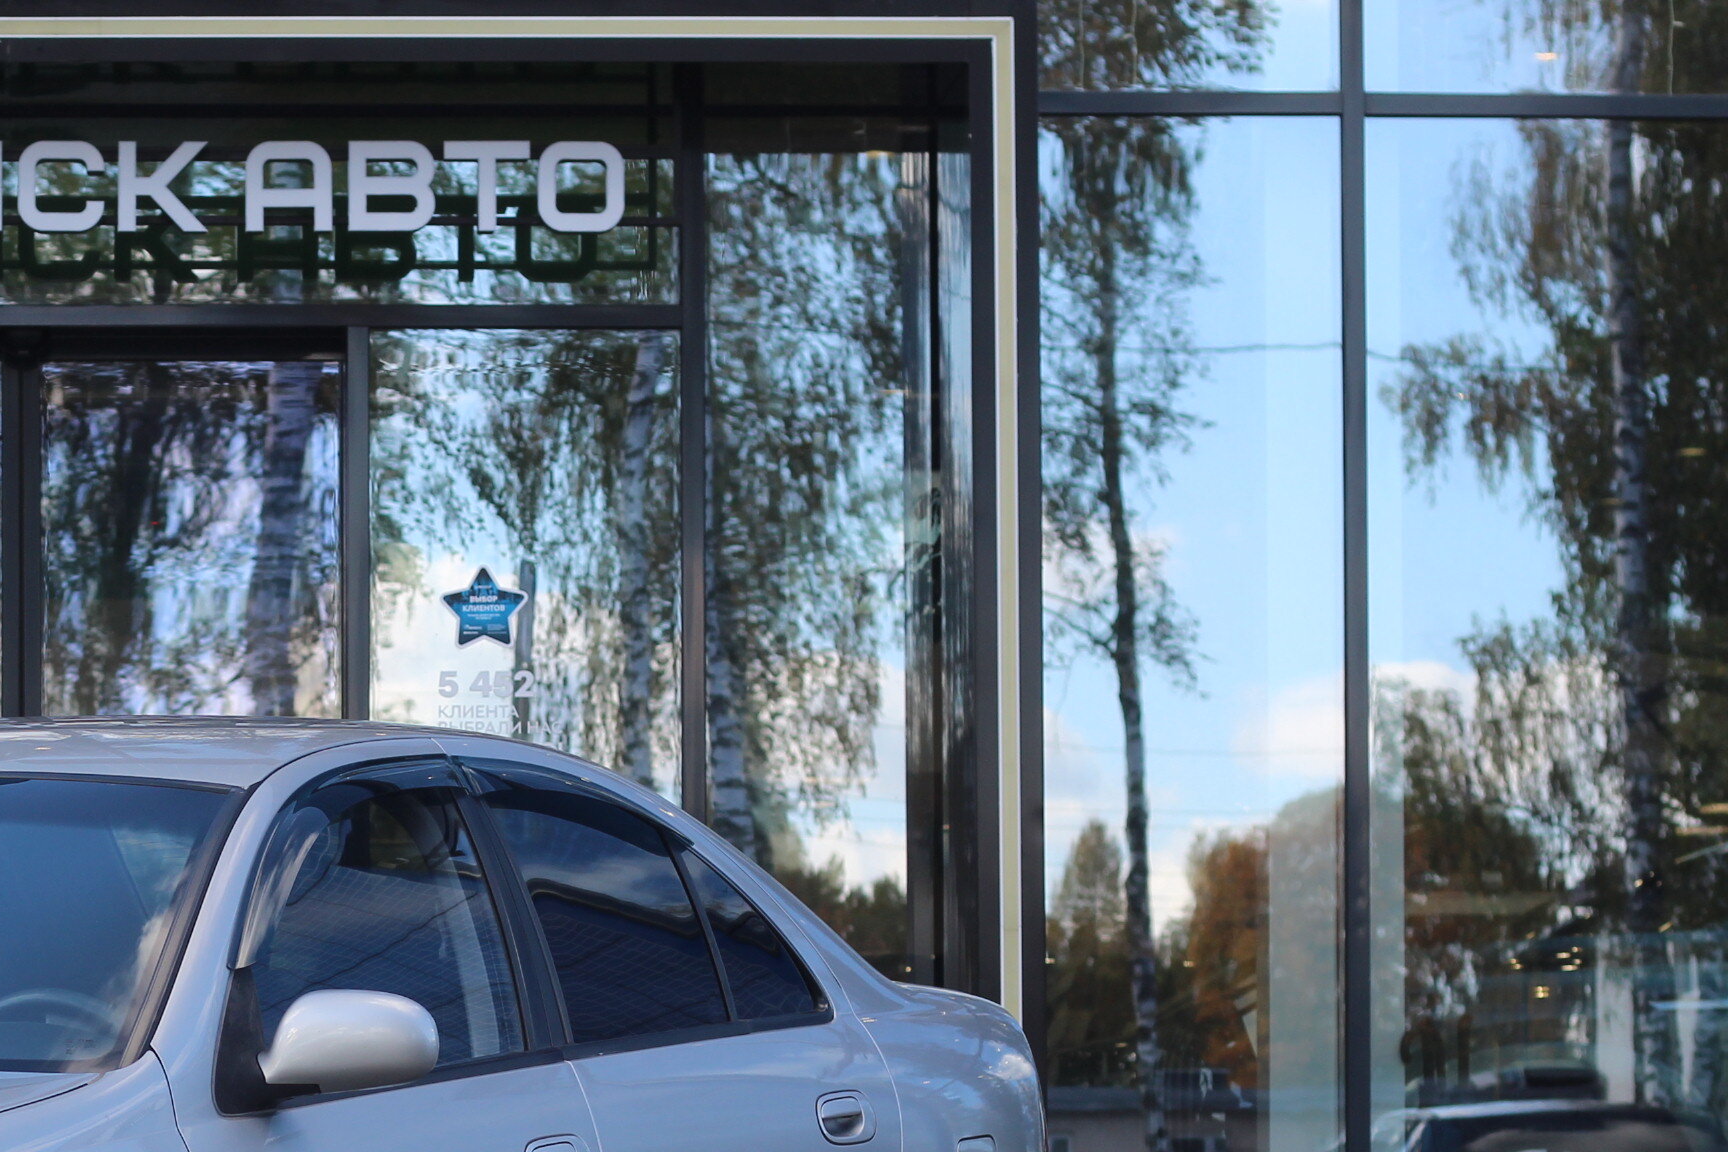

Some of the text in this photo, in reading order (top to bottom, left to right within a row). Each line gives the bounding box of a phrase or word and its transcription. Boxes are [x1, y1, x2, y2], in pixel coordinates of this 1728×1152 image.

[245, 140, 627, 232] АВТО
[469, 595, 498, 603] ВЫБОР
[462, 604, 506, 612] КЛИЕНТОВ
[438, 669, 535, 698] 5 452
[438, 704, 520, 719] КЛИЕНТА
